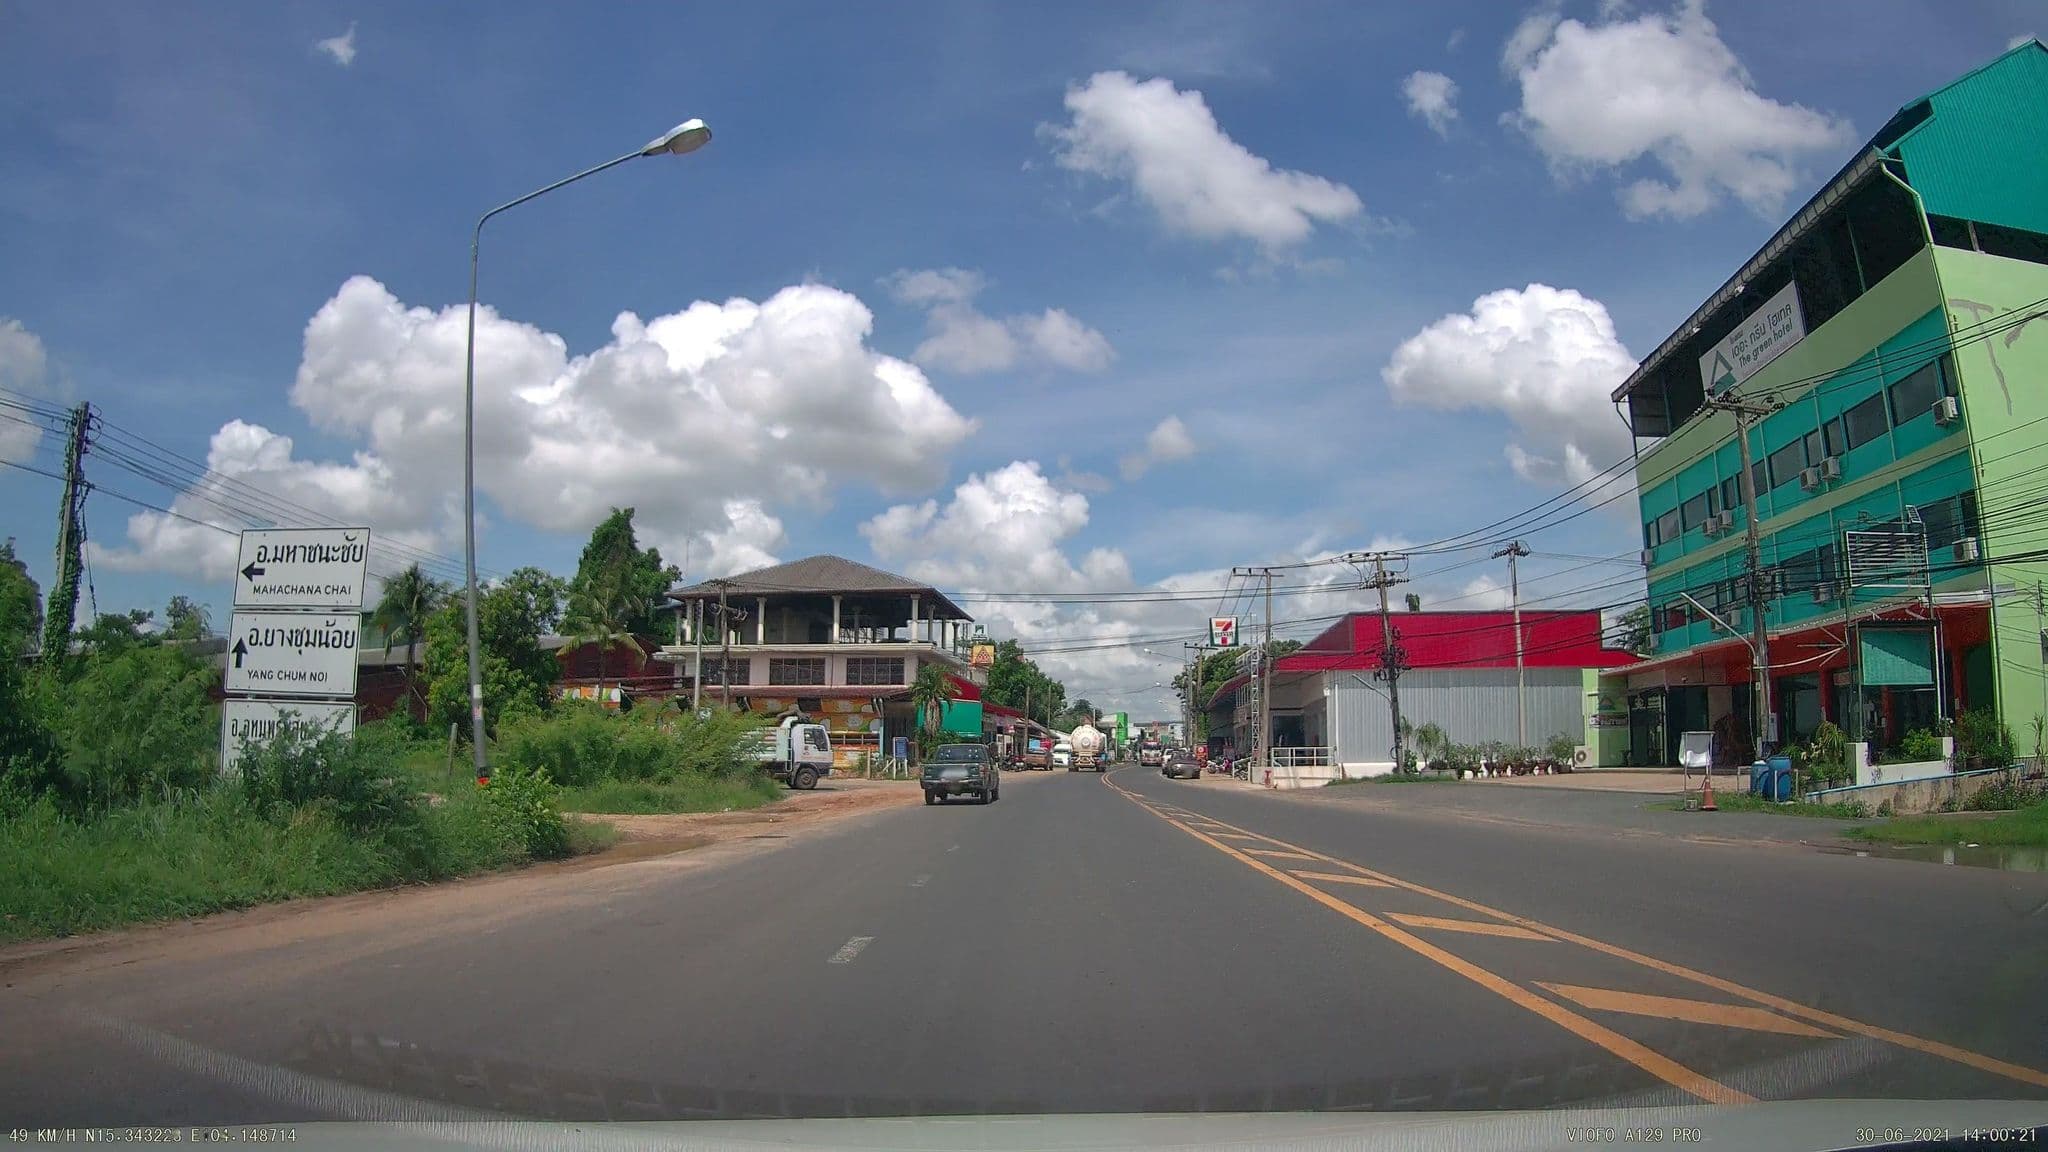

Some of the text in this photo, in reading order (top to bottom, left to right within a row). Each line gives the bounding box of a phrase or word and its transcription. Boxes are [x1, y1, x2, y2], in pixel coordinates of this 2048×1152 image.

[1739, 355, 1751, 368] The
[1752, 337, 1773, 361] green
[1773, 317, 1793, 341] hotel
[256, 534, 364, 564] อ.มหาชนะชัย
[253, 584, 352, 595] MAHACHANA CHAI
[248, 619, 356, 655] อ.ยางชุมน้อย
[247, 669, 328, 682] YANG CHUM NOI
